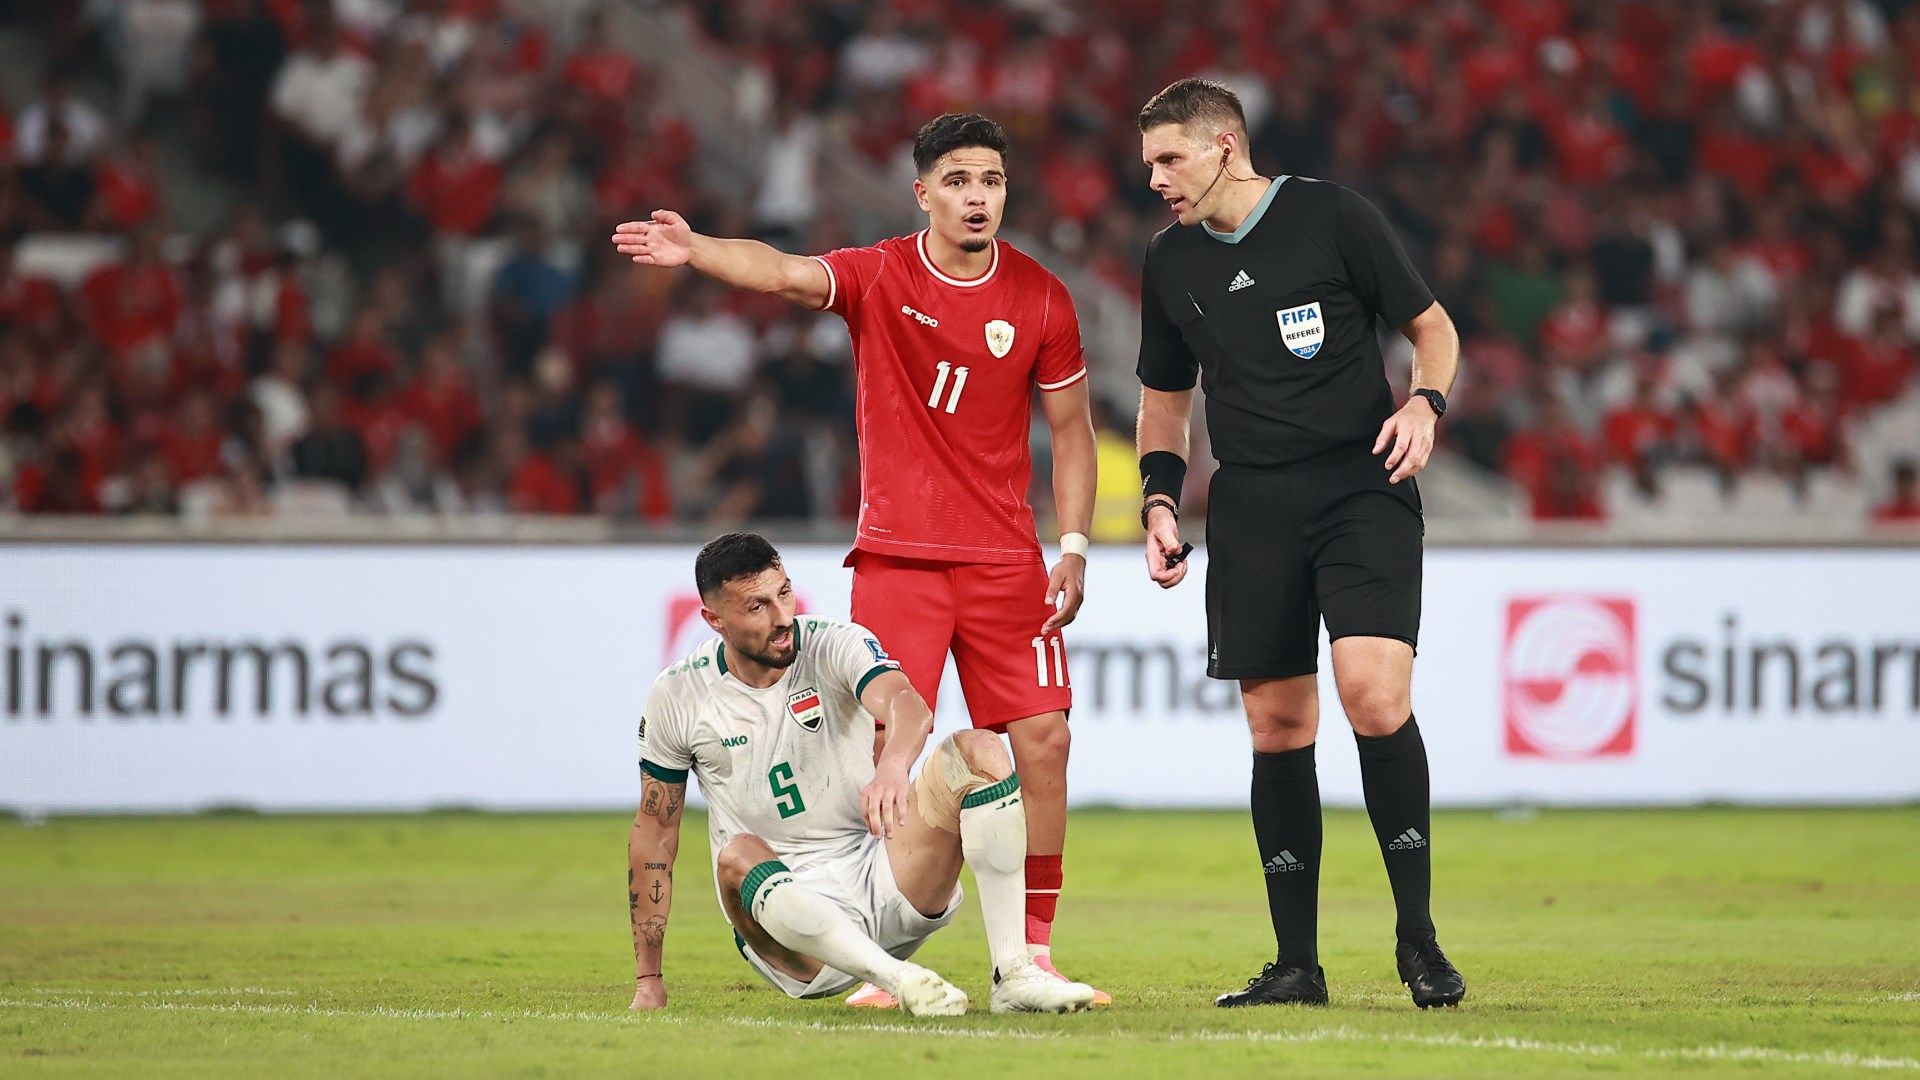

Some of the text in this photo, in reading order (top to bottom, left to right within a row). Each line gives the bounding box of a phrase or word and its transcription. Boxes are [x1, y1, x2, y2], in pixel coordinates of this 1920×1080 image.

[1228, 279, 1256, 292] adidas
[901, 305, 939, 328] erspo
[1281, 307, 1318, 326] FIFA
[1285, 326, 1321, 341] REFEREE
[1299, 345, 1316, 355] 2024
[927, 360, 969, 414] 11
[1031, 636, 1064, 687] 11
[1661, 613, 1920, 714] sinar
[792, 691, 812, 702] IRAQ
[768, 761, 806, 819] 5
[1388, 837, 1427, 851] adidas
[1263, 861, 1305, 874] adidas
